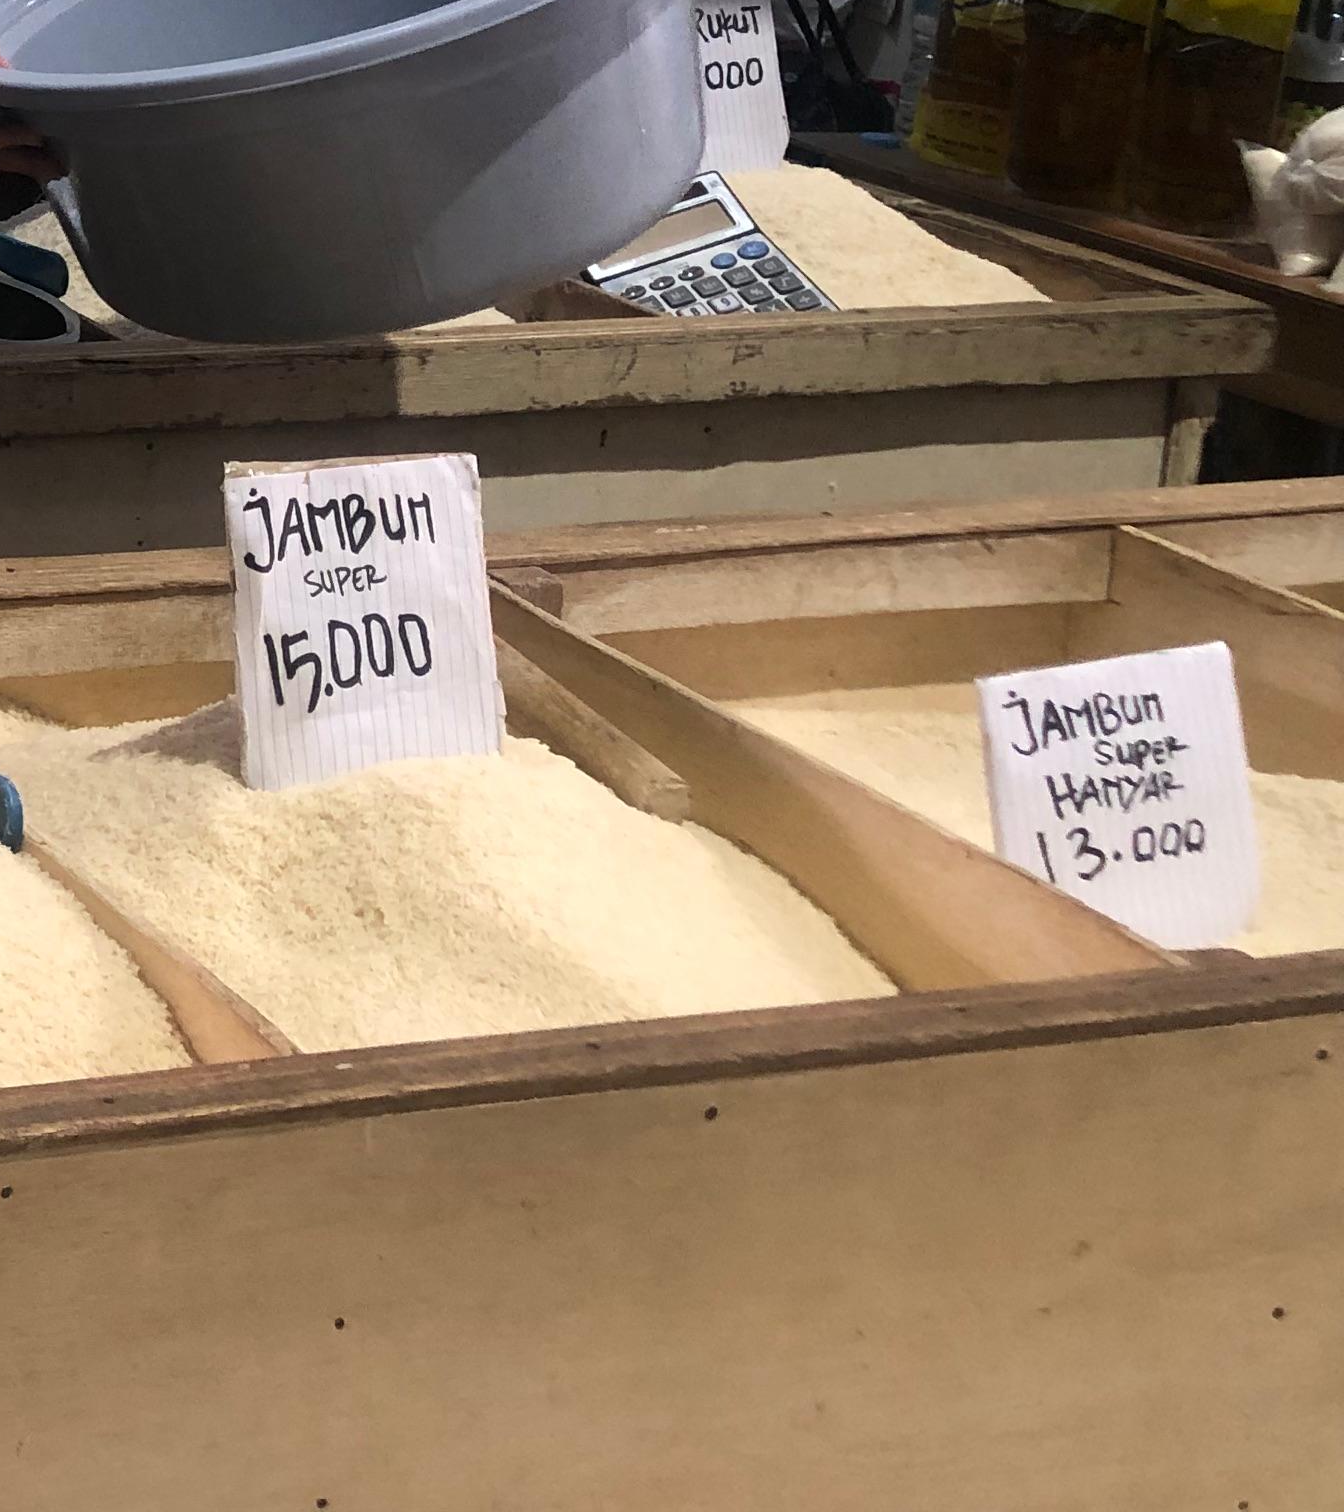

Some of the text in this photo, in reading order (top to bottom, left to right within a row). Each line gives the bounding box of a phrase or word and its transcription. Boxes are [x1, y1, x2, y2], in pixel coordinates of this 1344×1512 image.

[304, 564, 387, 597] SUPER
[264, 613, 432, 713] 15.000
[1094, 736, 1190, 769] SUPER
[1037, 818, 1205, 883] 13.000
